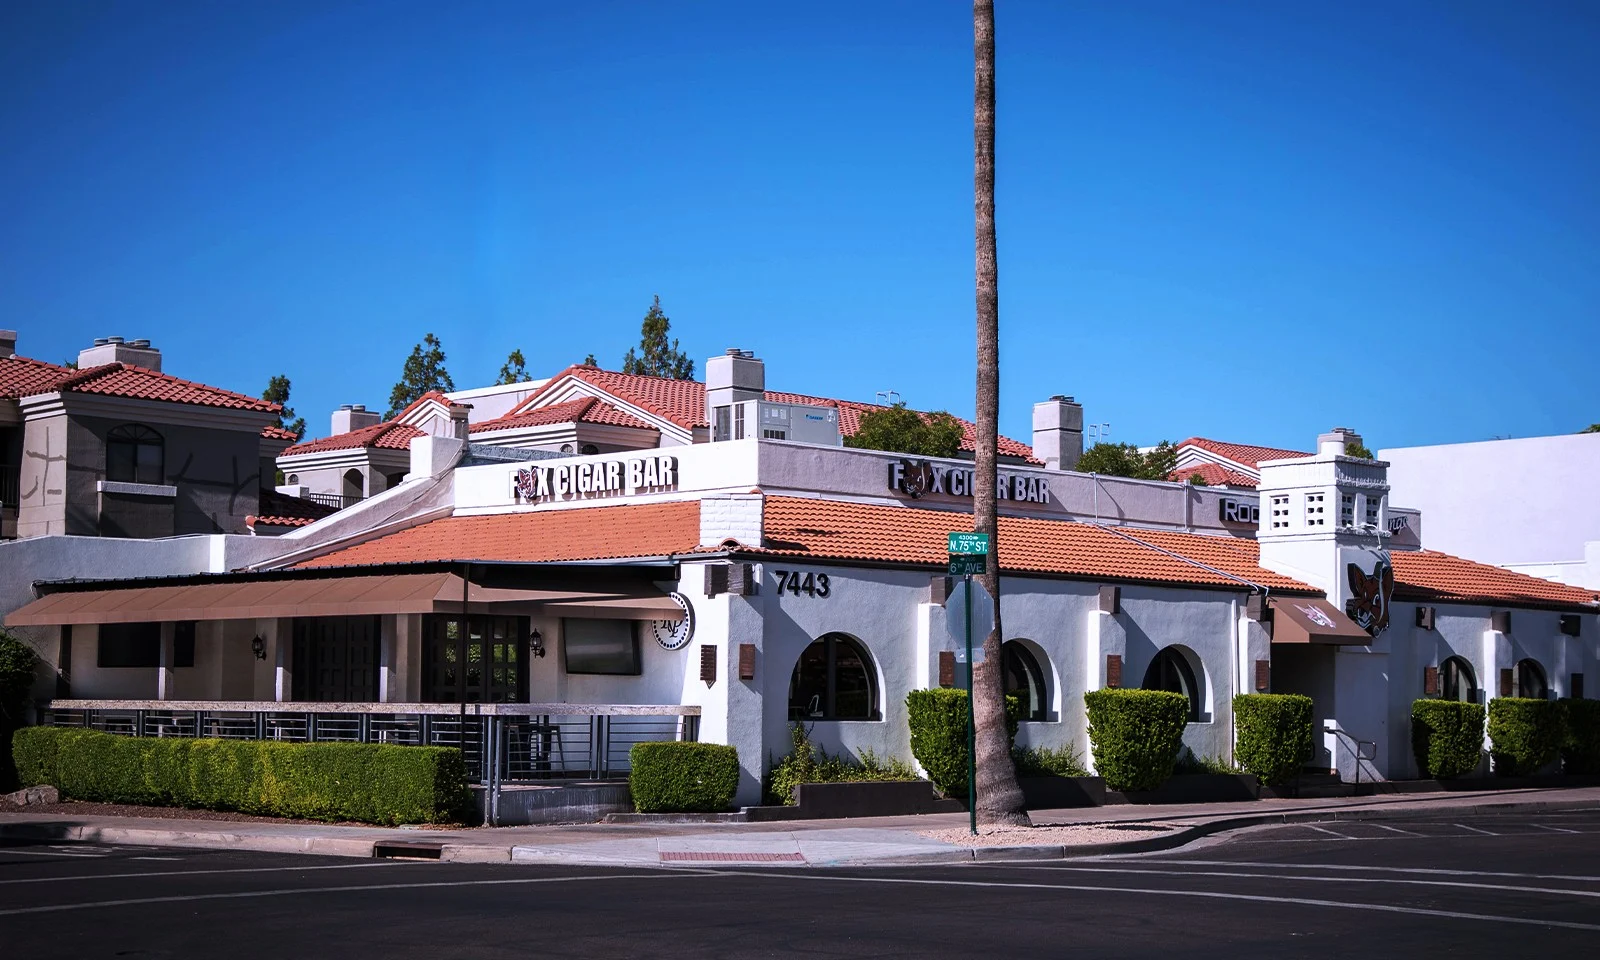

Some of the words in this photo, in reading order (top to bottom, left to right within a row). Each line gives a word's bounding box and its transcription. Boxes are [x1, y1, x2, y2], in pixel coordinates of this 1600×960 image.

[553, 461, 624, 495] CIGAR
[629, 456, 677, 488] BAR
[949, 468, 1008, 500] CIR
[1013, 475, 1050, 504] BAR
[950, 540, 958, 550] N.
[959, 540, 975, 551] 75TH
[975, 541, 988, 552] ST.
[950, 563, 963, 573] 6TH
[964, 562, 985, 573] AVE.
[775, 570, 830, 597] 7443
